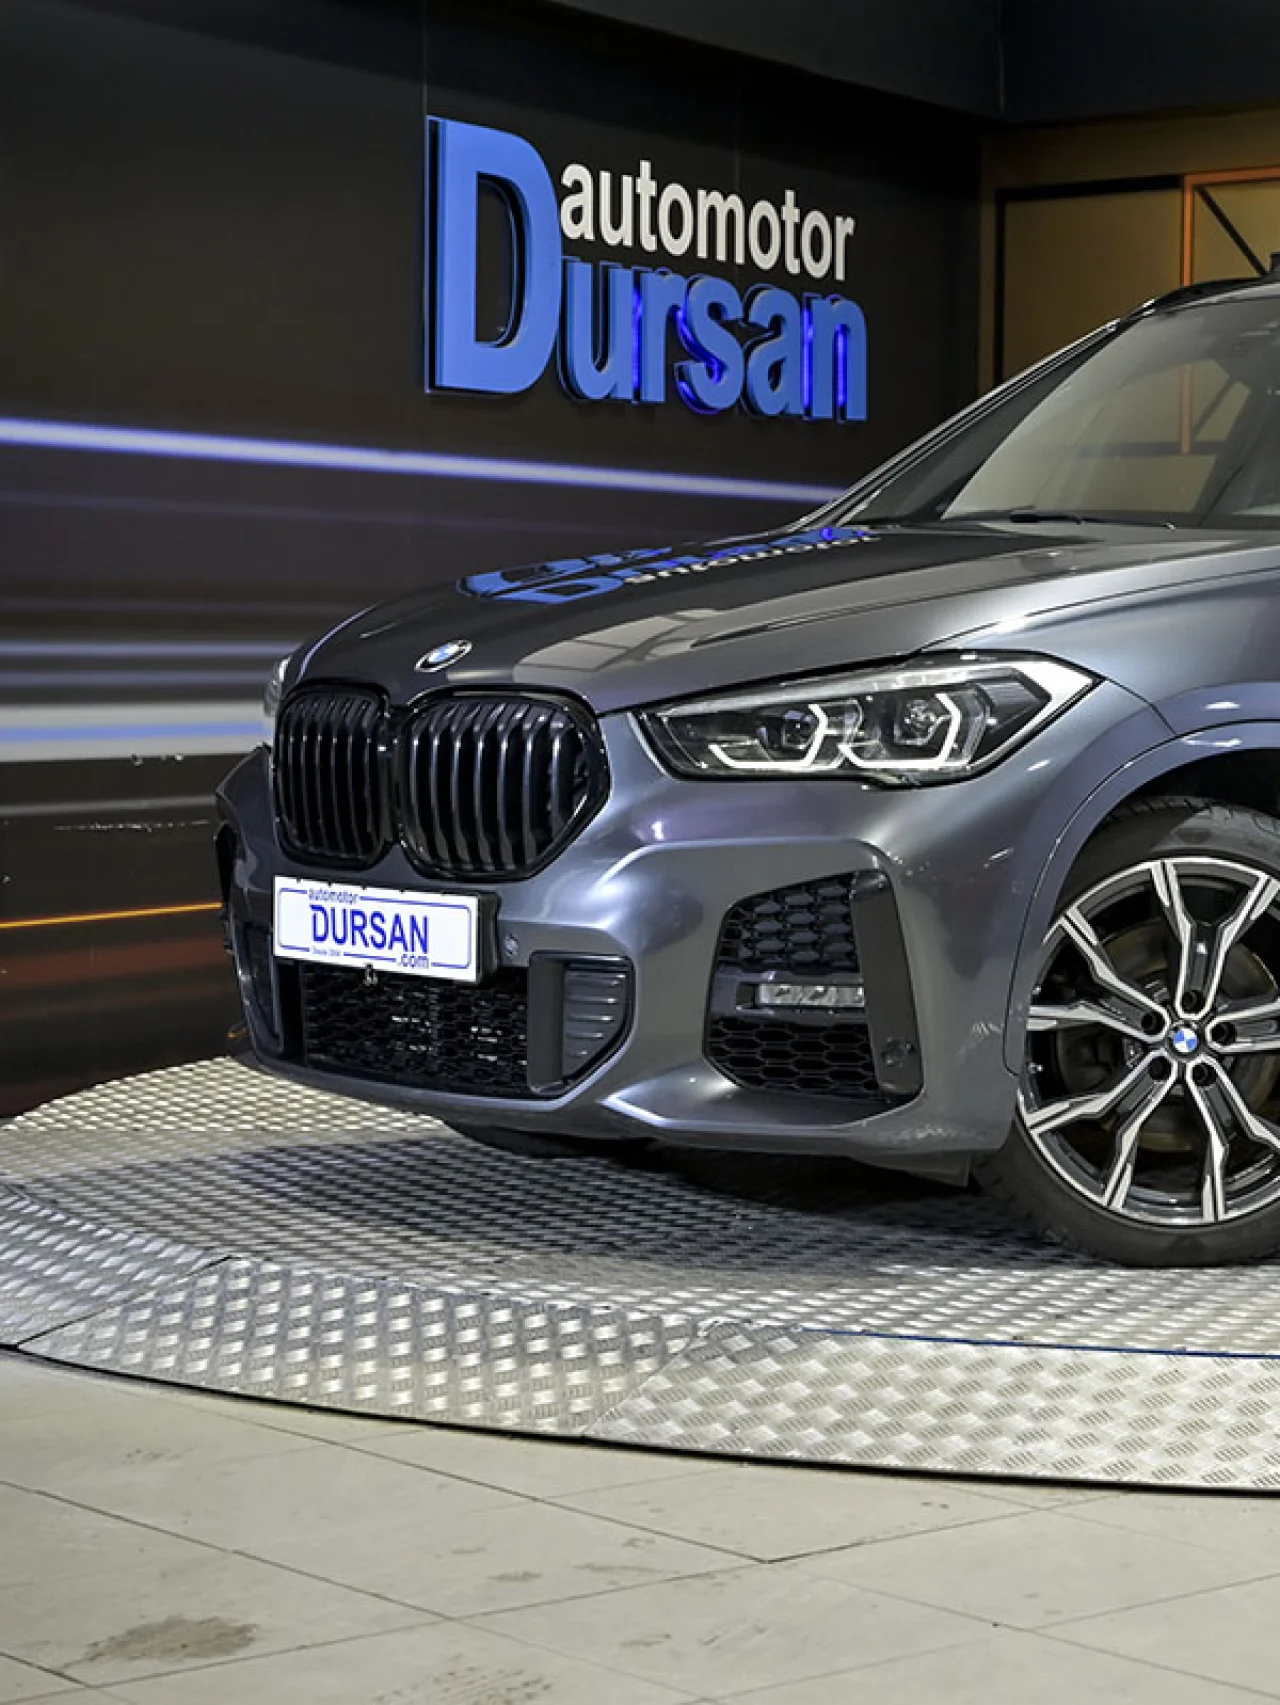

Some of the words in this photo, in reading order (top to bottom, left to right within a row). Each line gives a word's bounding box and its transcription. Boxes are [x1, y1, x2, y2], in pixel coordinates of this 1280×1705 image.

[427, 115, 868, 421] Dursan
[560, 160, 856, 281] automotor
[309, 904, 429, 954] DURSAN
